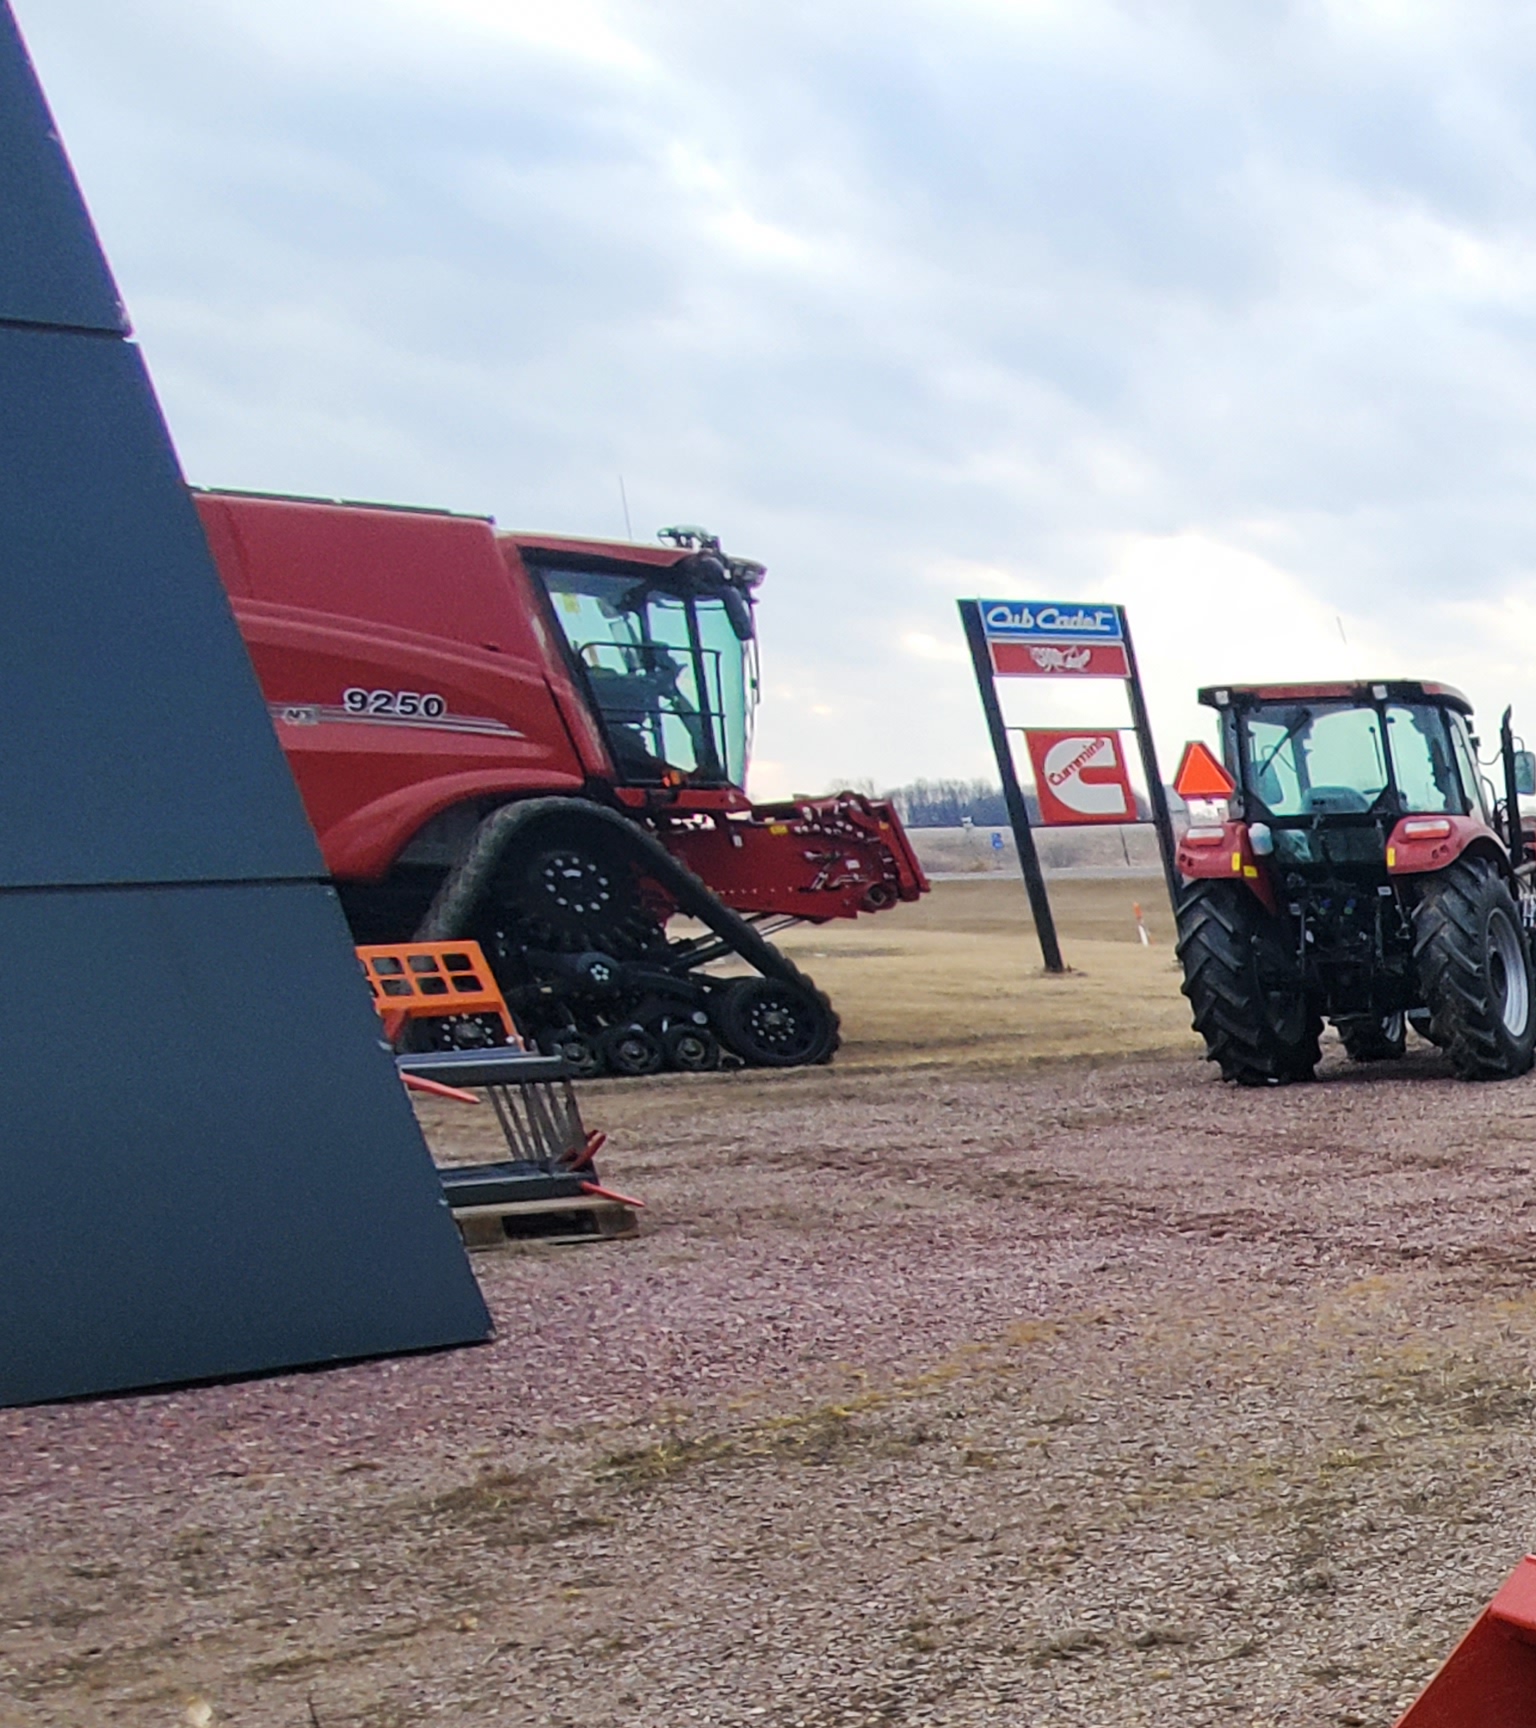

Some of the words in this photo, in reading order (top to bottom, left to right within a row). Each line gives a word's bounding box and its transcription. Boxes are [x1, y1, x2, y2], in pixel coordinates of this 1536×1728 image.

[987, 606, 1034, 628] Cub
[1036, 608, 1113, 631] Cadet
[344, 687, 446, 718] 9250
[1048, 739, 1105, 786] Cummins
